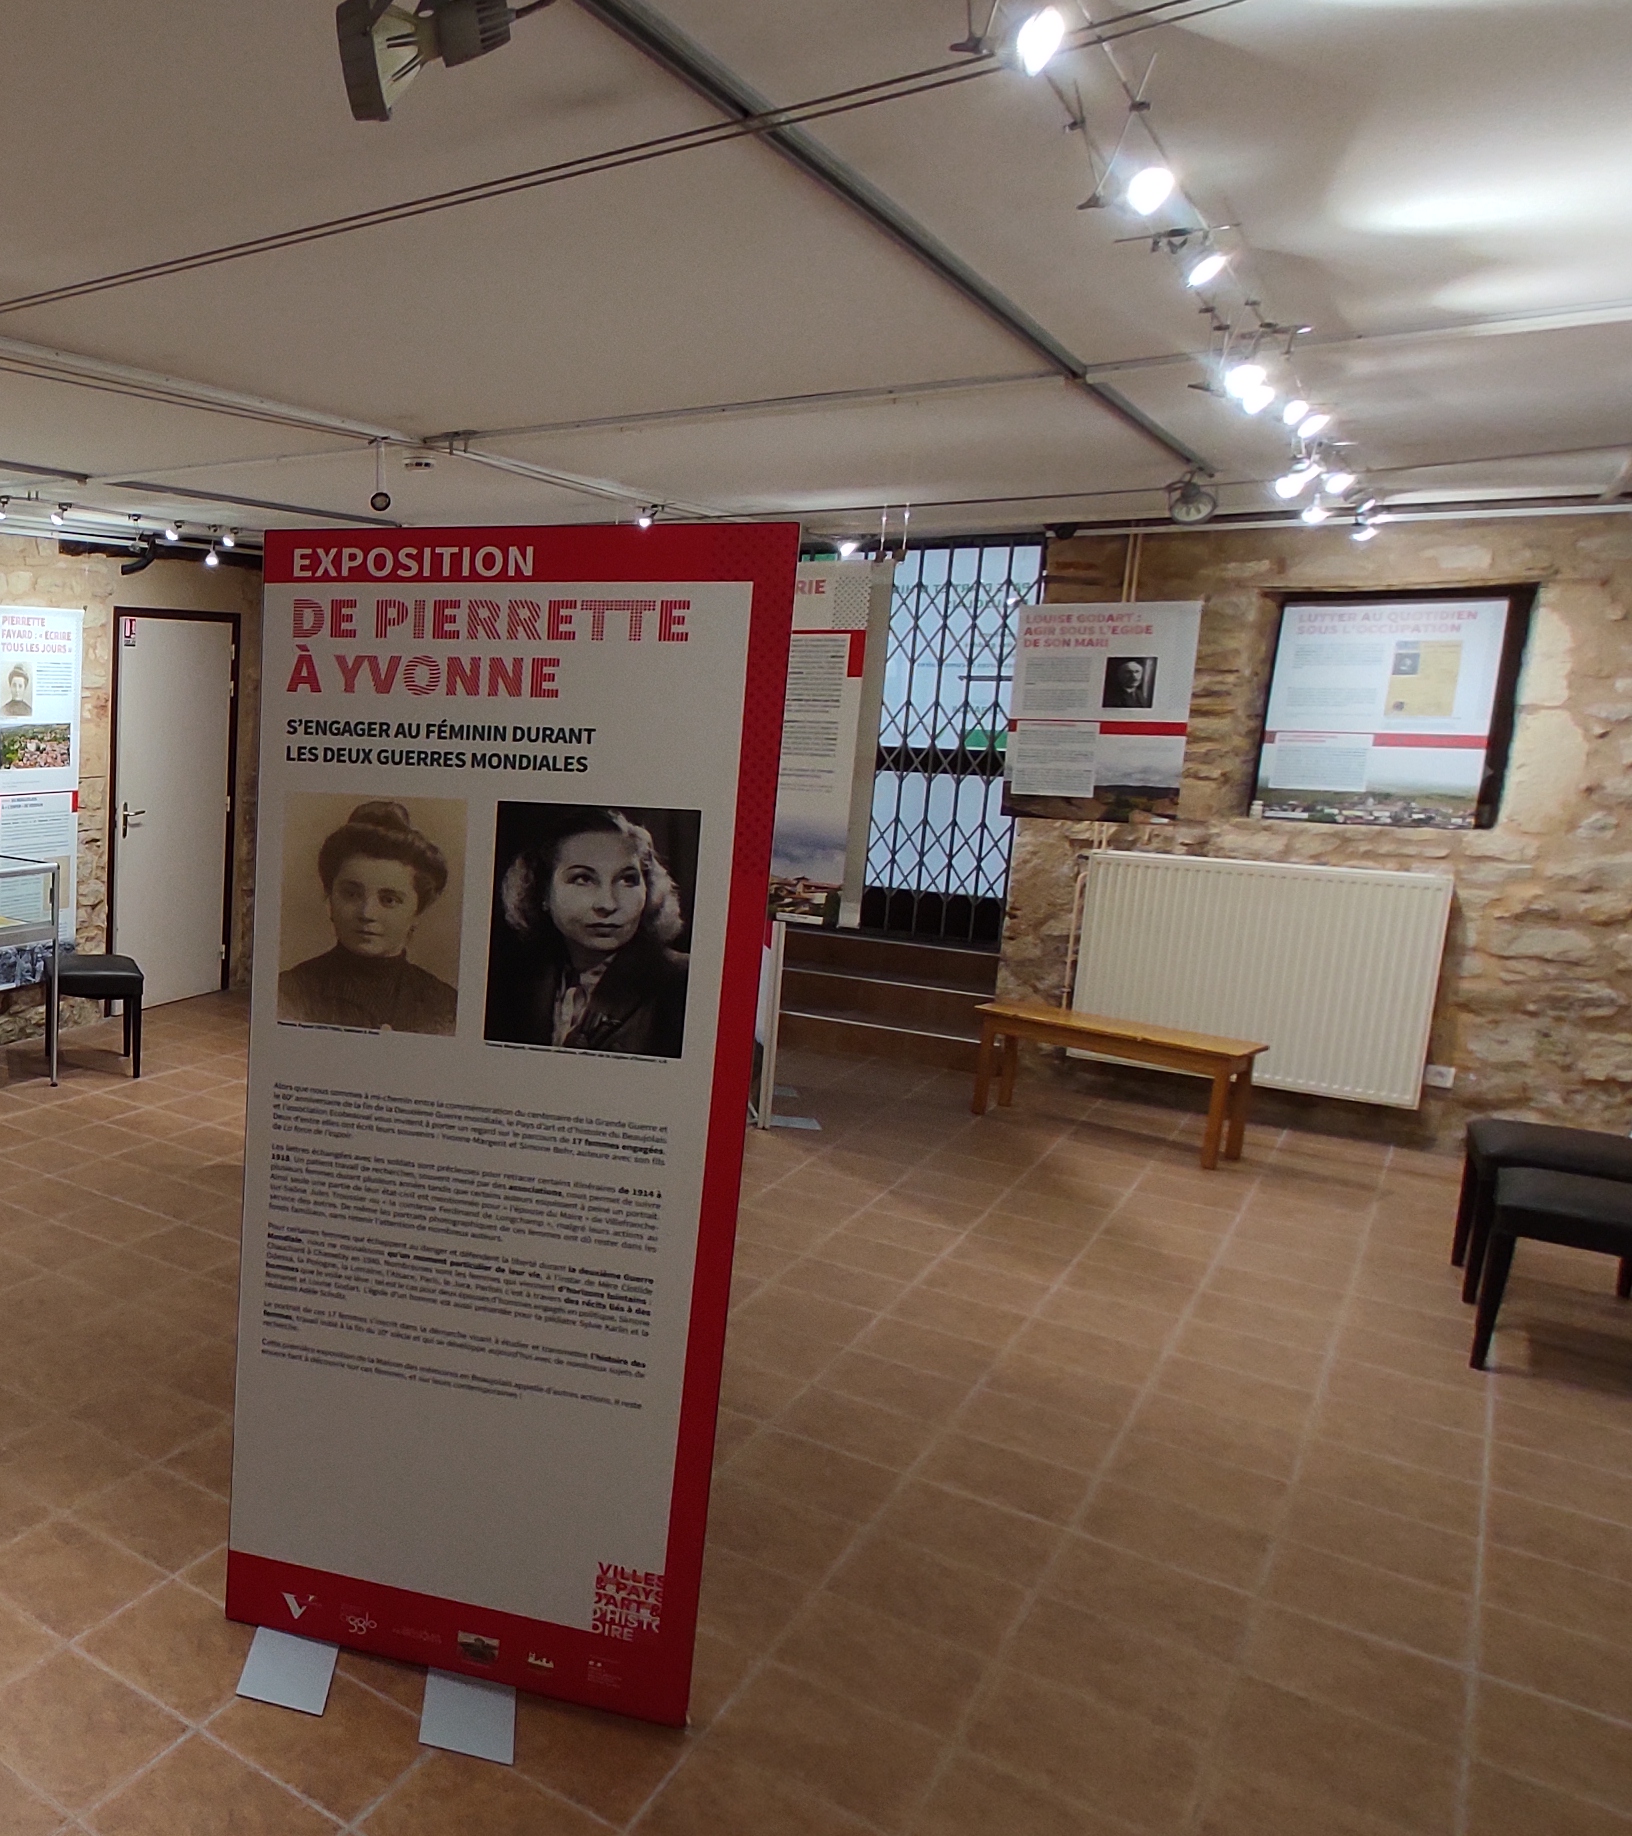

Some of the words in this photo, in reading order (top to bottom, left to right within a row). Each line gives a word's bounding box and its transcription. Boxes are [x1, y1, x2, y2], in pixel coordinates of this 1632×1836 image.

[292, 544, 535, 578] EXPOSITION
[1, 615, 46, 627] PIERRETTE
[292, 597, 358, 639] DE
[374, 597, 691, 642] PIERRETTE
[1025, 613, 1074, 624] LOUISE
[1076, 612, 1134, 623] GODART
[1298, 612, 1357, 624] LUTTER
[1360, 611, 1383, 622] AU
[1387, 610, 1479, 624] QUOTIDIEN
[1, 628, 33, 640] FAYARD
[1024, 626, 1057, 636] AGIR
[1059, 625, 1096, 636] SOUS
[1296, 624, 1338, 635] SOUS
[1342, 623, 1462, 635] L'OCCUPATION
[0, 642, 24, 653] TOUS
[25, 642, 40, 653] LES
[41, 643, 67, 654] JOURS
[1023, 638, 1040, 648] DE
[1042, 638, 1071, 648] SON
[1074, 638, 1110, 648] MARI
[286, 644, 323, 693] À
[333, 653, 562, 699] YVONNE
[286, 718, 391, 739] S'ENGAGER
[394, 721, 422, 740] AU
[425, 717, 507, 743] FÉMININ
[511, 725, 597, 746] DURANT
[286, 745, 319, 763] LES
[322, 746, 373, 766] DEUX
[376, 748, 467, 770] GUERRES
[471, 752, 588, 774] MONDIALES
[584, 1138, 619, 1149] femmes
[632, 1187, 654, 1197] 1914
[597, 1561, 664, 1588] VILLES
